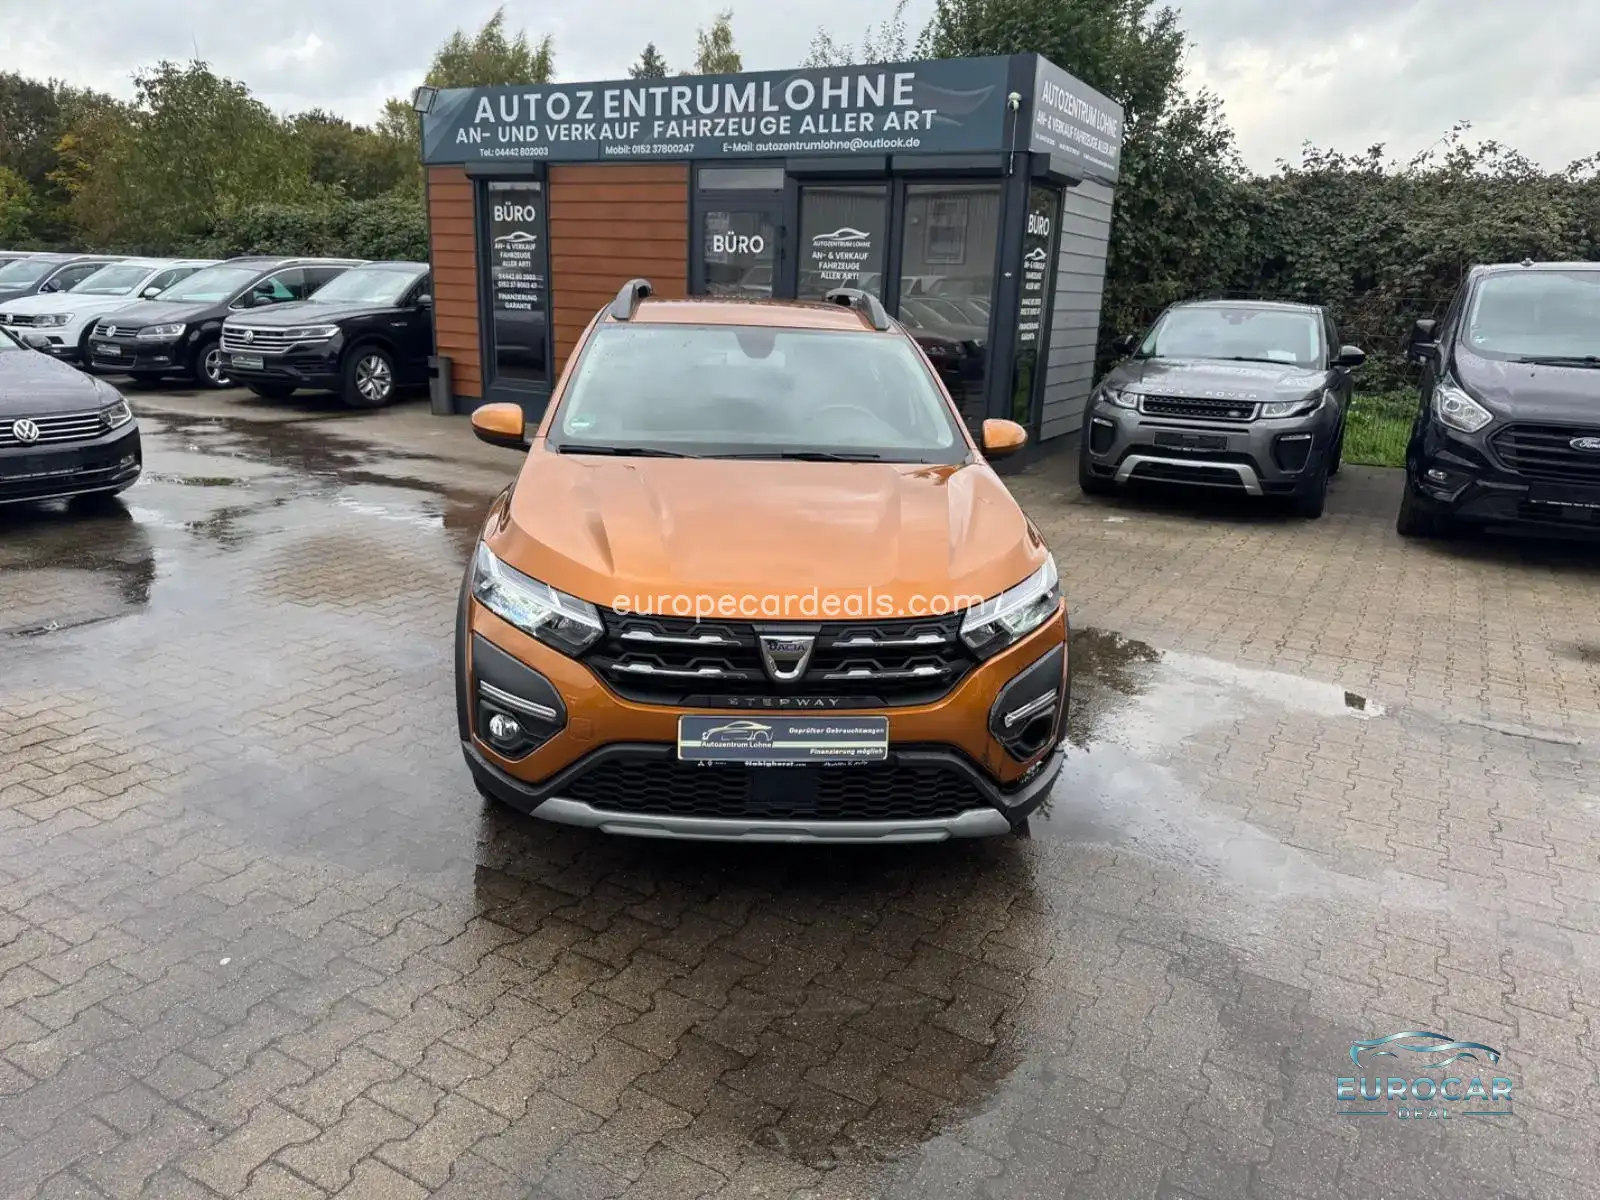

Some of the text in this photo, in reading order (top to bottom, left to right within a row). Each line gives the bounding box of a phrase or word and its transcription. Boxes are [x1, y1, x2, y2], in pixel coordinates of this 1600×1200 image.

[456, 109, 937, 144] AN- UND VERKAUF FAHRZEUGE ALLER ART
[632, 144, 651, 154] 0152
[652, 143, 695, 153] 37800247
[756, 137, 920, 151] autozentrumlohne@outlook.de
[520, 146, 549, 157] 802003
[494, 201, 536, 222] BÜRO
[1027, 210, 1050, 235] BÜRO
[713, 231, 765, 253] BÜRO
[835, 252, 869, 260] VERKAUF
[818, 261, 860, 270] FAHRZEUGE
[820, 271, 841, 280] ALLER
[701, 740, 772, 748] Autozentrum Lohne
[810, 748, 855, 756] Finanzierung
